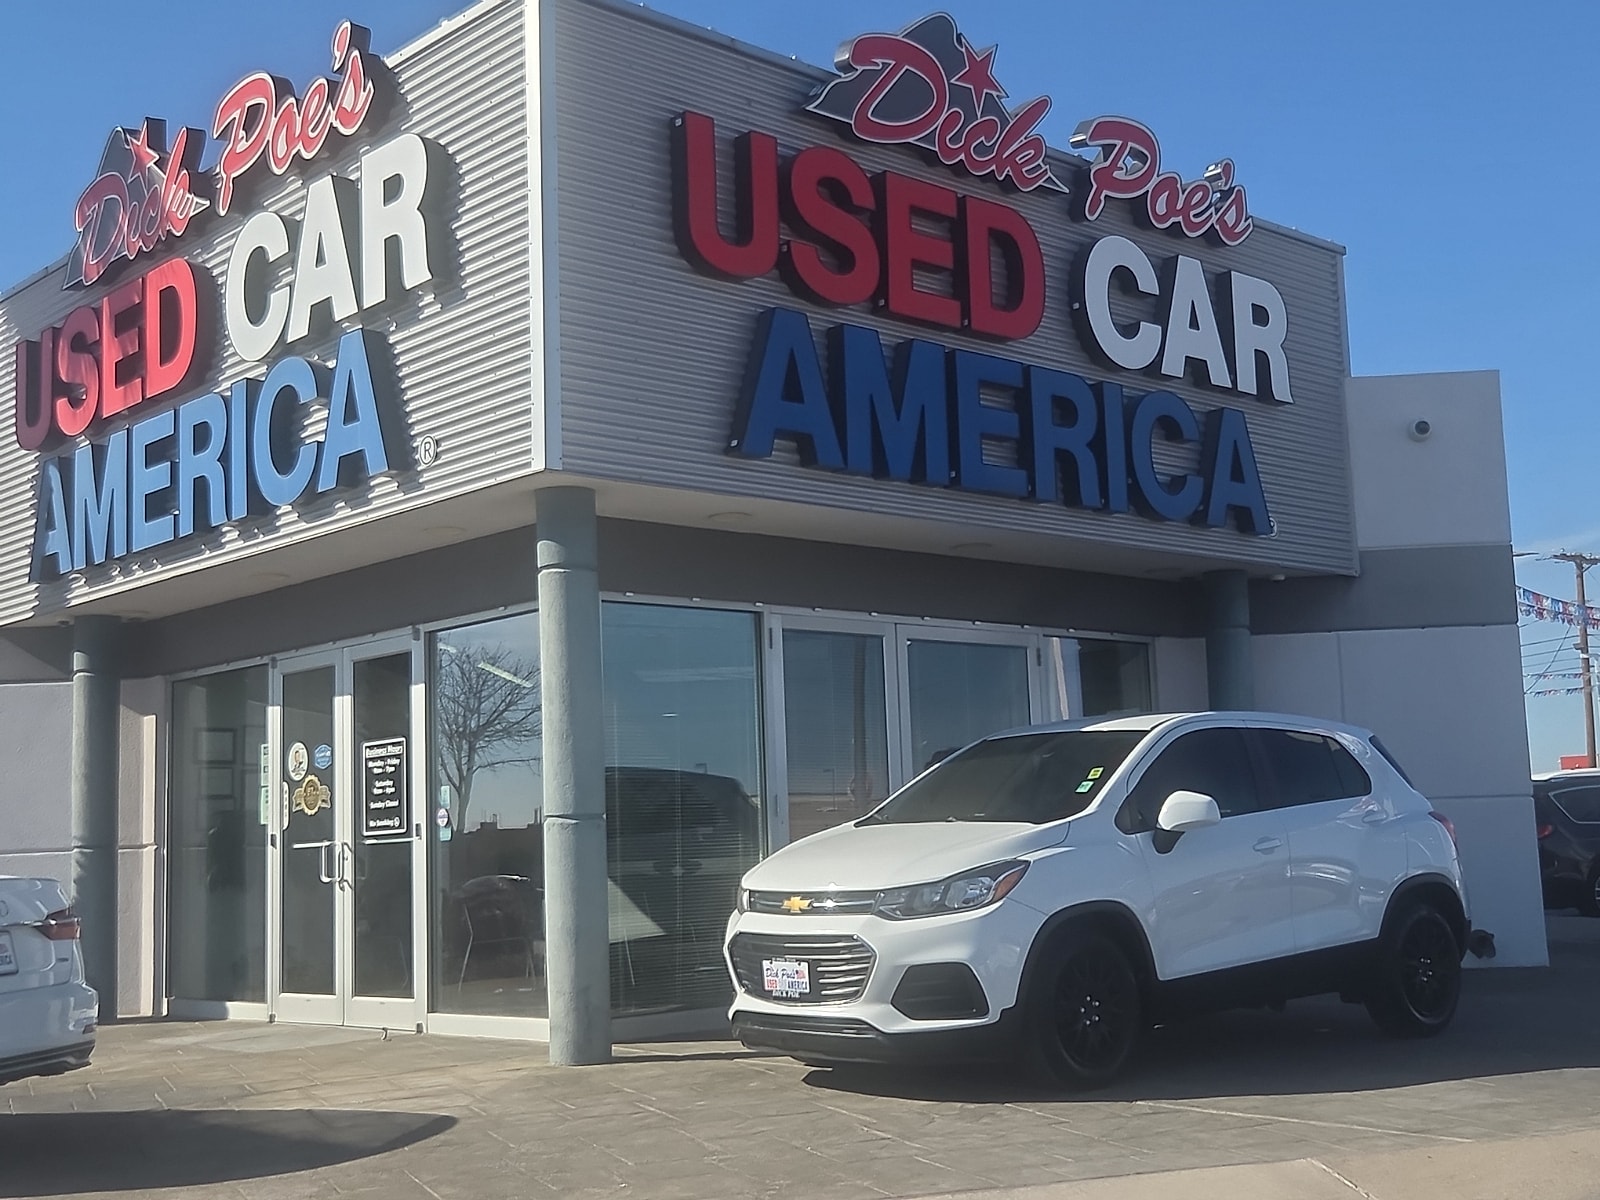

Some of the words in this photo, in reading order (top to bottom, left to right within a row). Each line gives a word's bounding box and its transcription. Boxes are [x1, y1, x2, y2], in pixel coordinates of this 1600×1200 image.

[75, 126, 191, 287] Dick
[213, 19, 374, 217] Poe's
[680, 110, 1046, 340] USED
[1084, 235, 1294, 405] CAR
[850, 32, 1053, 192] Dick
[1084, 115, 1253, 247] Poe's
[16, 257, 198, 451] USED
[225, 133, 432, 361] CAR
[38, 329, 389, 575] AMERICA
[738, 307, 1272, 537] AMERICA
